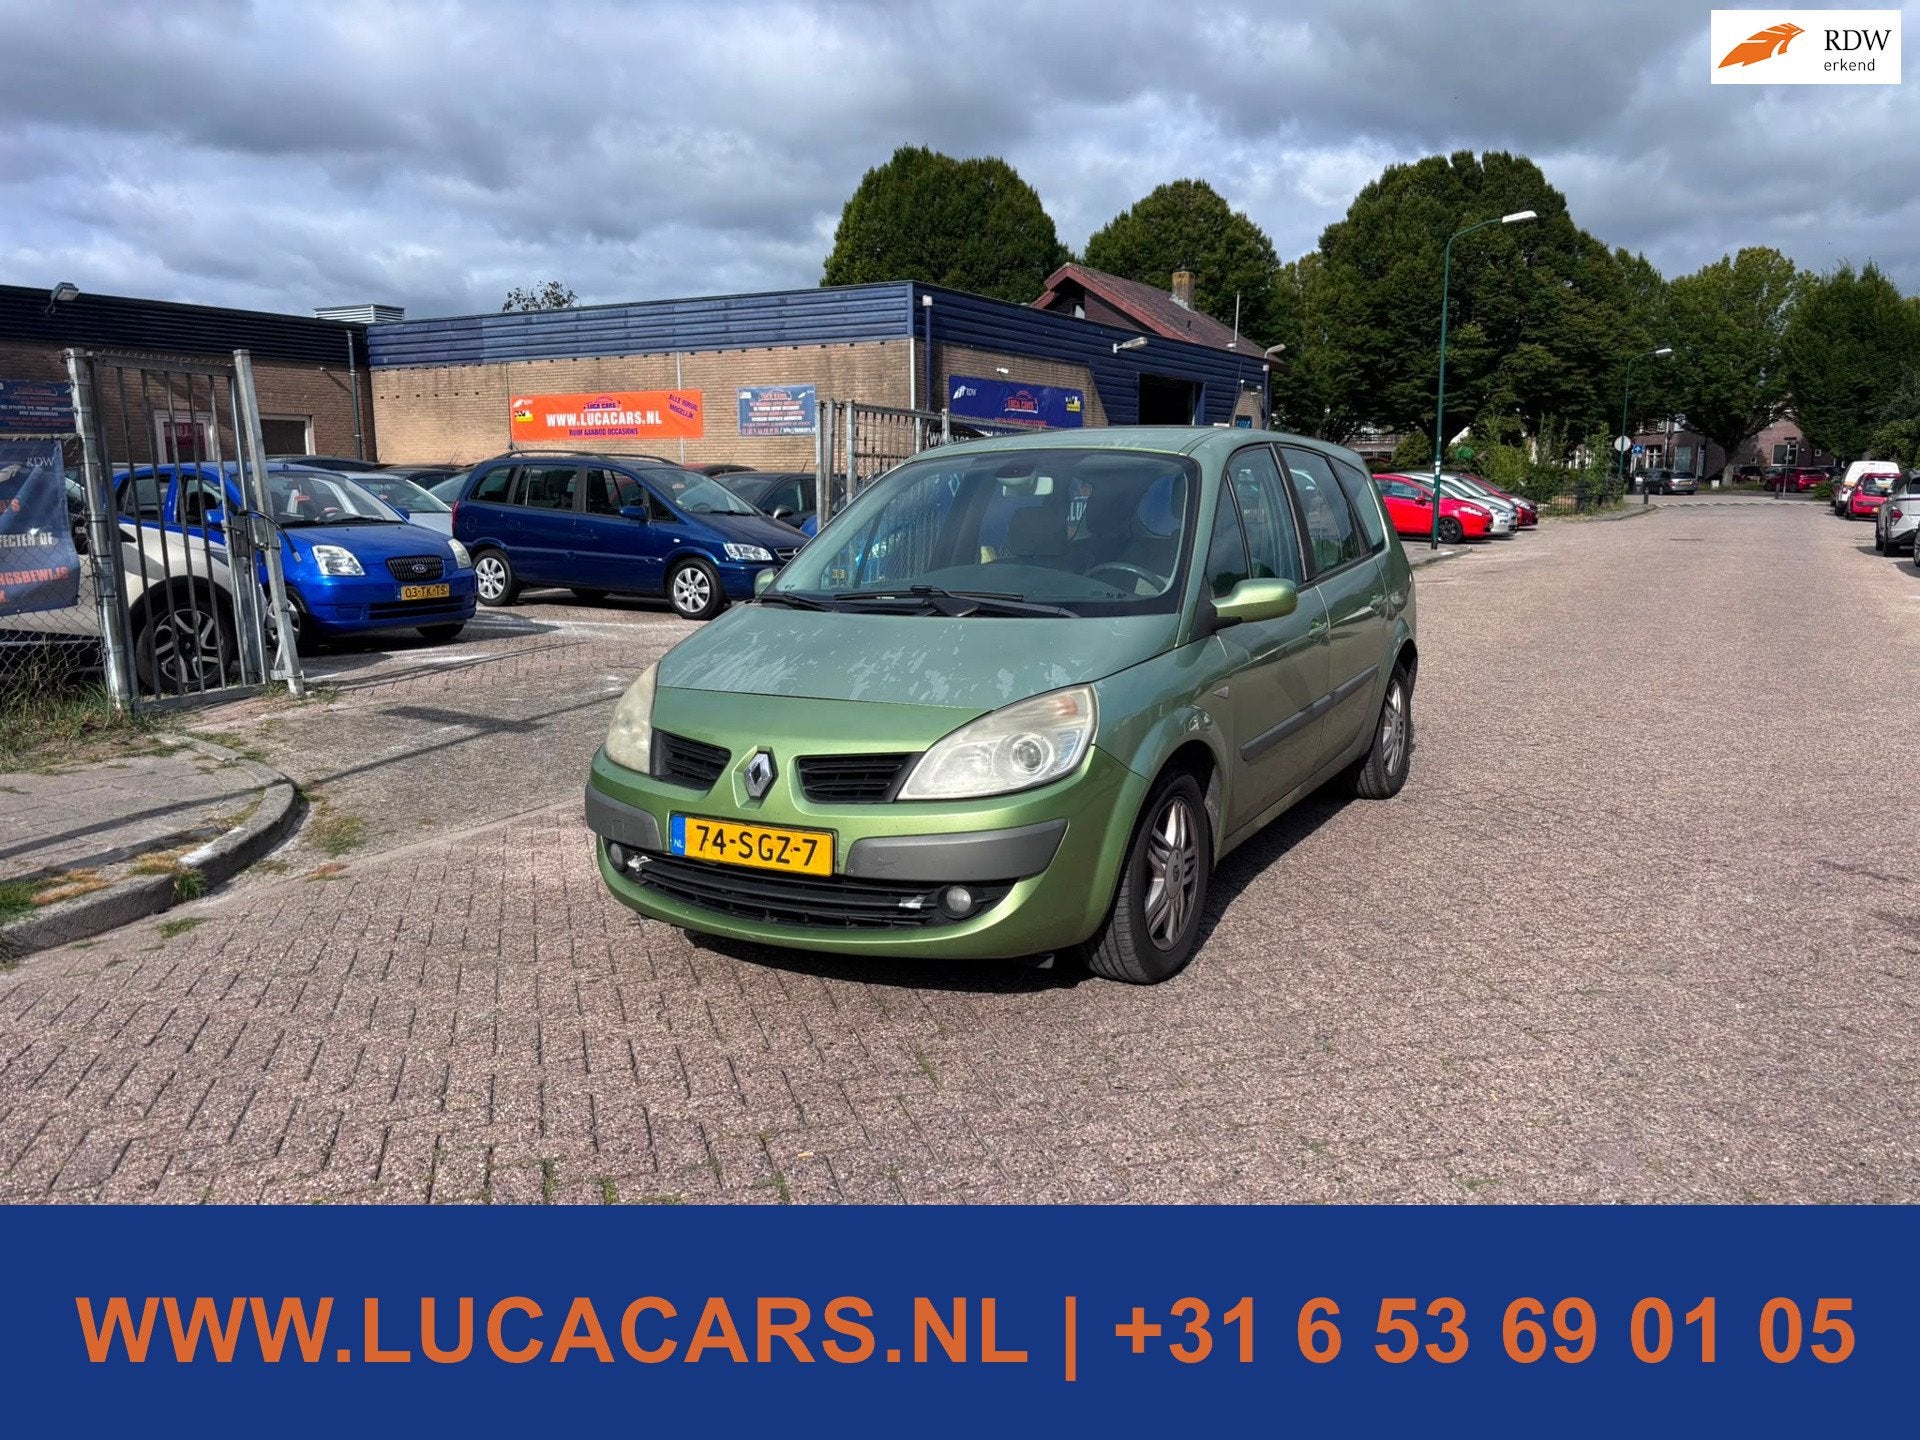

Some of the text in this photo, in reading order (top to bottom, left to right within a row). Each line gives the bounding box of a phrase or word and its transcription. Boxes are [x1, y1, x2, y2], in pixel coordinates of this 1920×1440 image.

[545, 410, 663, 428] WWW.LUCACARS.NL
[607, 428, 639, 436] OCCASIONS
[405, 585, 447, 598] 03-TK-TS
[673, 840, 684, 849] NL
[696, 825, 818, 866] 74-SGZ-7
